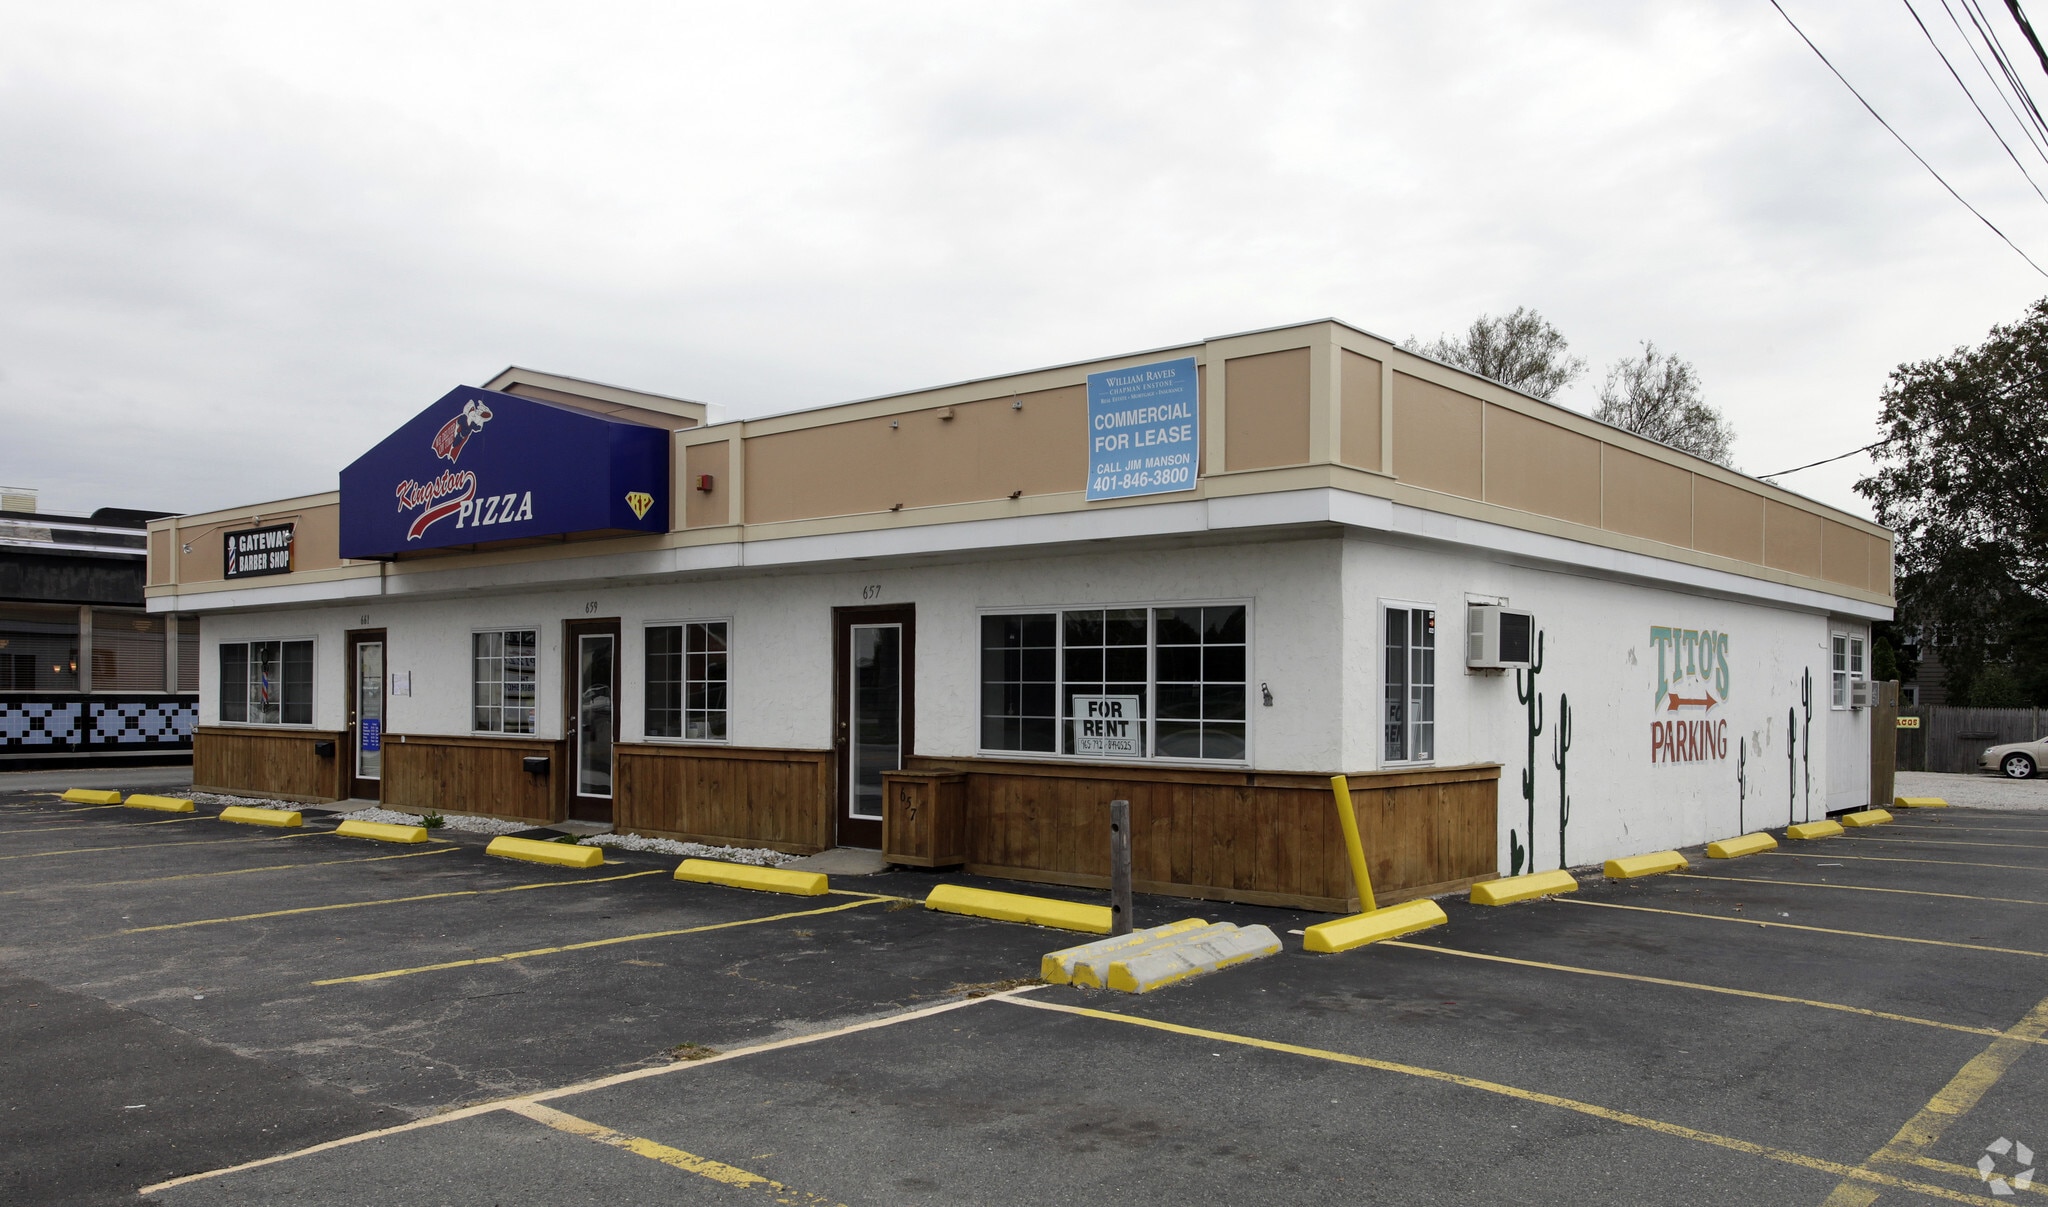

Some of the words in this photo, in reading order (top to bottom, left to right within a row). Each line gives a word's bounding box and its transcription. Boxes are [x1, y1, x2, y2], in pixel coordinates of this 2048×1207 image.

[1106, 374, 1144, 388] WILLIAM
[1146, 369, 1176, 381] RAVEIS
[1109, 385, 1141, 396] CHAPMAN
[1143, 380, 1173, 390] ENSTONE
[1094, 402, 1192, 431] COMMERCIAL
[1095, 433, 1129, 453] FOR
[1135, 424, 1192, 447] LEASE
[1096, 462, 1122, 475] CALL
[1125, 458, 1142, 471] JIM
[1145, 453, 1190, 469] MANSON
[1093, 466, 1189, 492] 401-846-3800
[396, 469, 466, 512] Kingston
[456, 491, 533, 528] PIZZA
[239, 554, 267, 572] BARBER
[269, 551, 289, 569] SHOP
[863, 585, 881, 600] 657
[585, 601, 598, 614] 659
[1650, 625, 1729, 712] TITO'S
[1088, 701, 1122, 718] FOR
[1083, 720, 1129, 737] RENT
[1897, 718, 1918, 727] ACOS
[1651, 719, 1727, 763] PARKING
